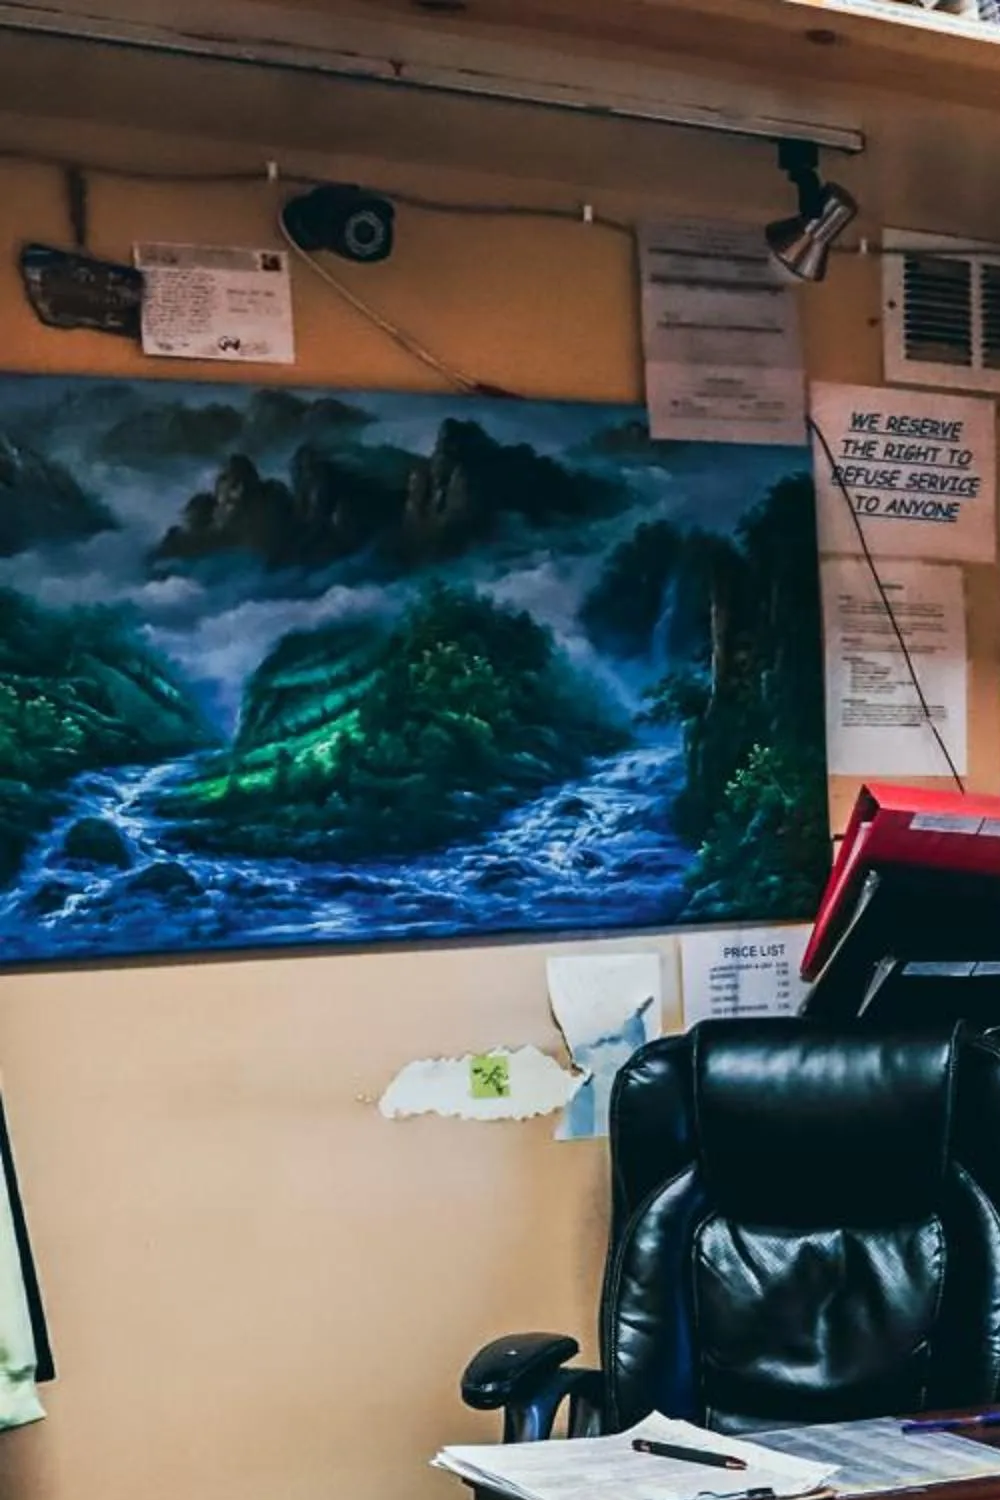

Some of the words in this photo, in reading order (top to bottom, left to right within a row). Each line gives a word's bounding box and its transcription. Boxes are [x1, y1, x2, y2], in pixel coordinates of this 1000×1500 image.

[851, 411, 881, 431] WE
[885, 415, 964, 441] RESERVE
[842, 439, 880, 459] THE
[883, 443, 943, 464] RIGHT
[950, 448, 974, 466] TO
[831, 465, 901, 488] REFUSE
[904, 471, 981, 495] SERVICE
[855, 495, 880, 513] TO
[885, 498, 961, 520] ANYONE
[761, 943, 785, 957] LIST
